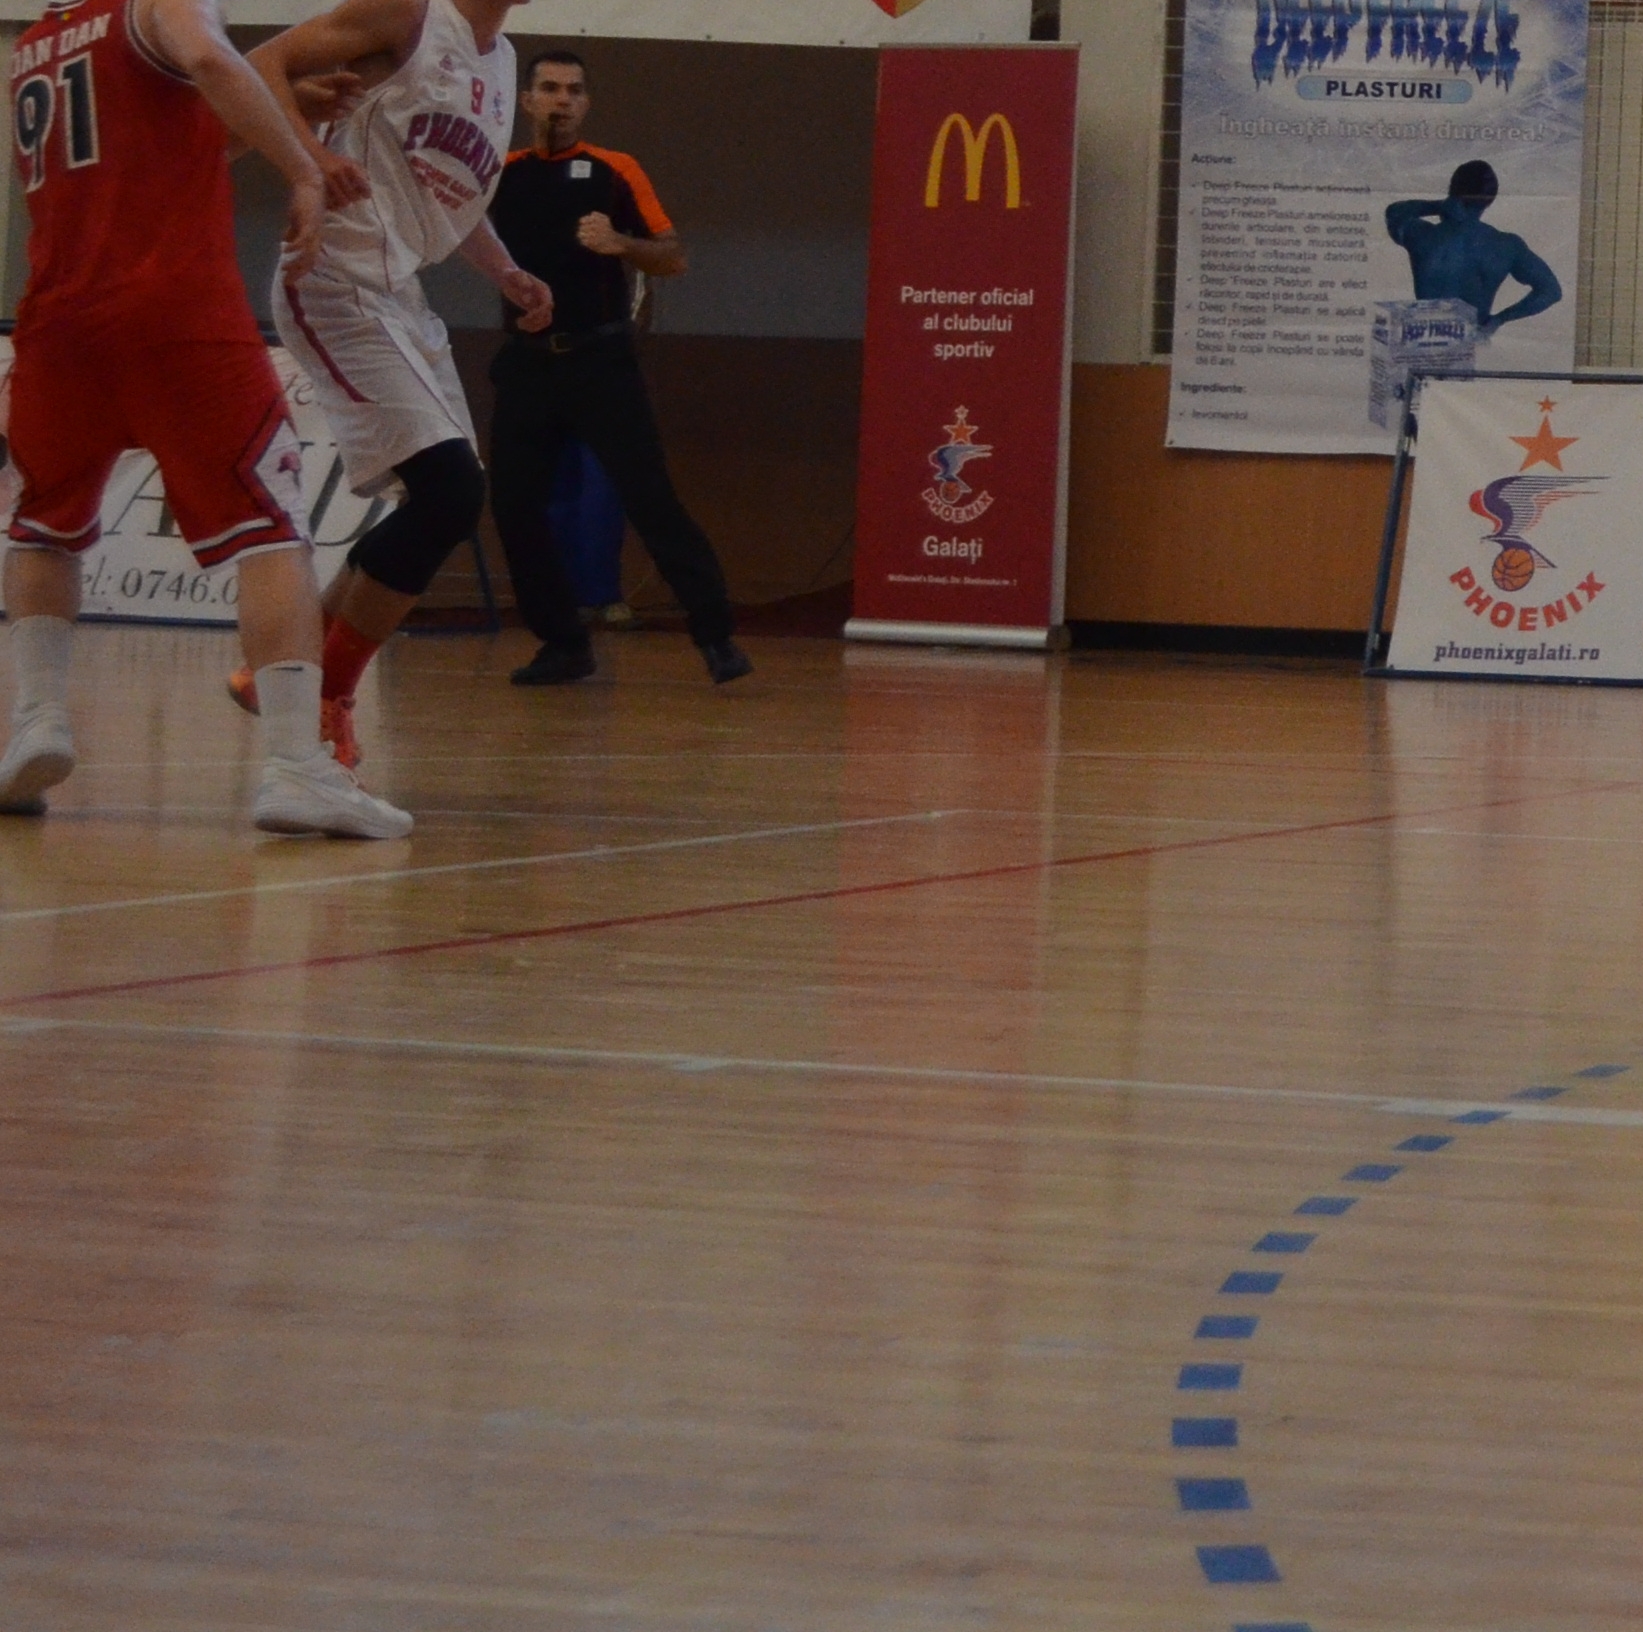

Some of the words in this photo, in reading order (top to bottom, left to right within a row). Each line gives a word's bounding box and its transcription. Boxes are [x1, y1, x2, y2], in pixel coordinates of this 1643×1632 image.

[1325, 79, 1442, 100] PLASTURI
[16, 52, 99, 193] 91
[1339, 117, 1428, 140] instant
[901, 285, 977, 304] Partener
[980, 288, 1034, 306] oficial
[923, 313, 938, 330] al
[943, 313, 1012, 331] clubului
[934, 340, 995, 361] sportiv
[921, 487, 995, 523] PHOENIX
[922, 535, 984, 565] Galați
[1449, 566, 1606, 631] PHOENIX
[1433, 640, 1600, 665] phoenixgalati.ro
